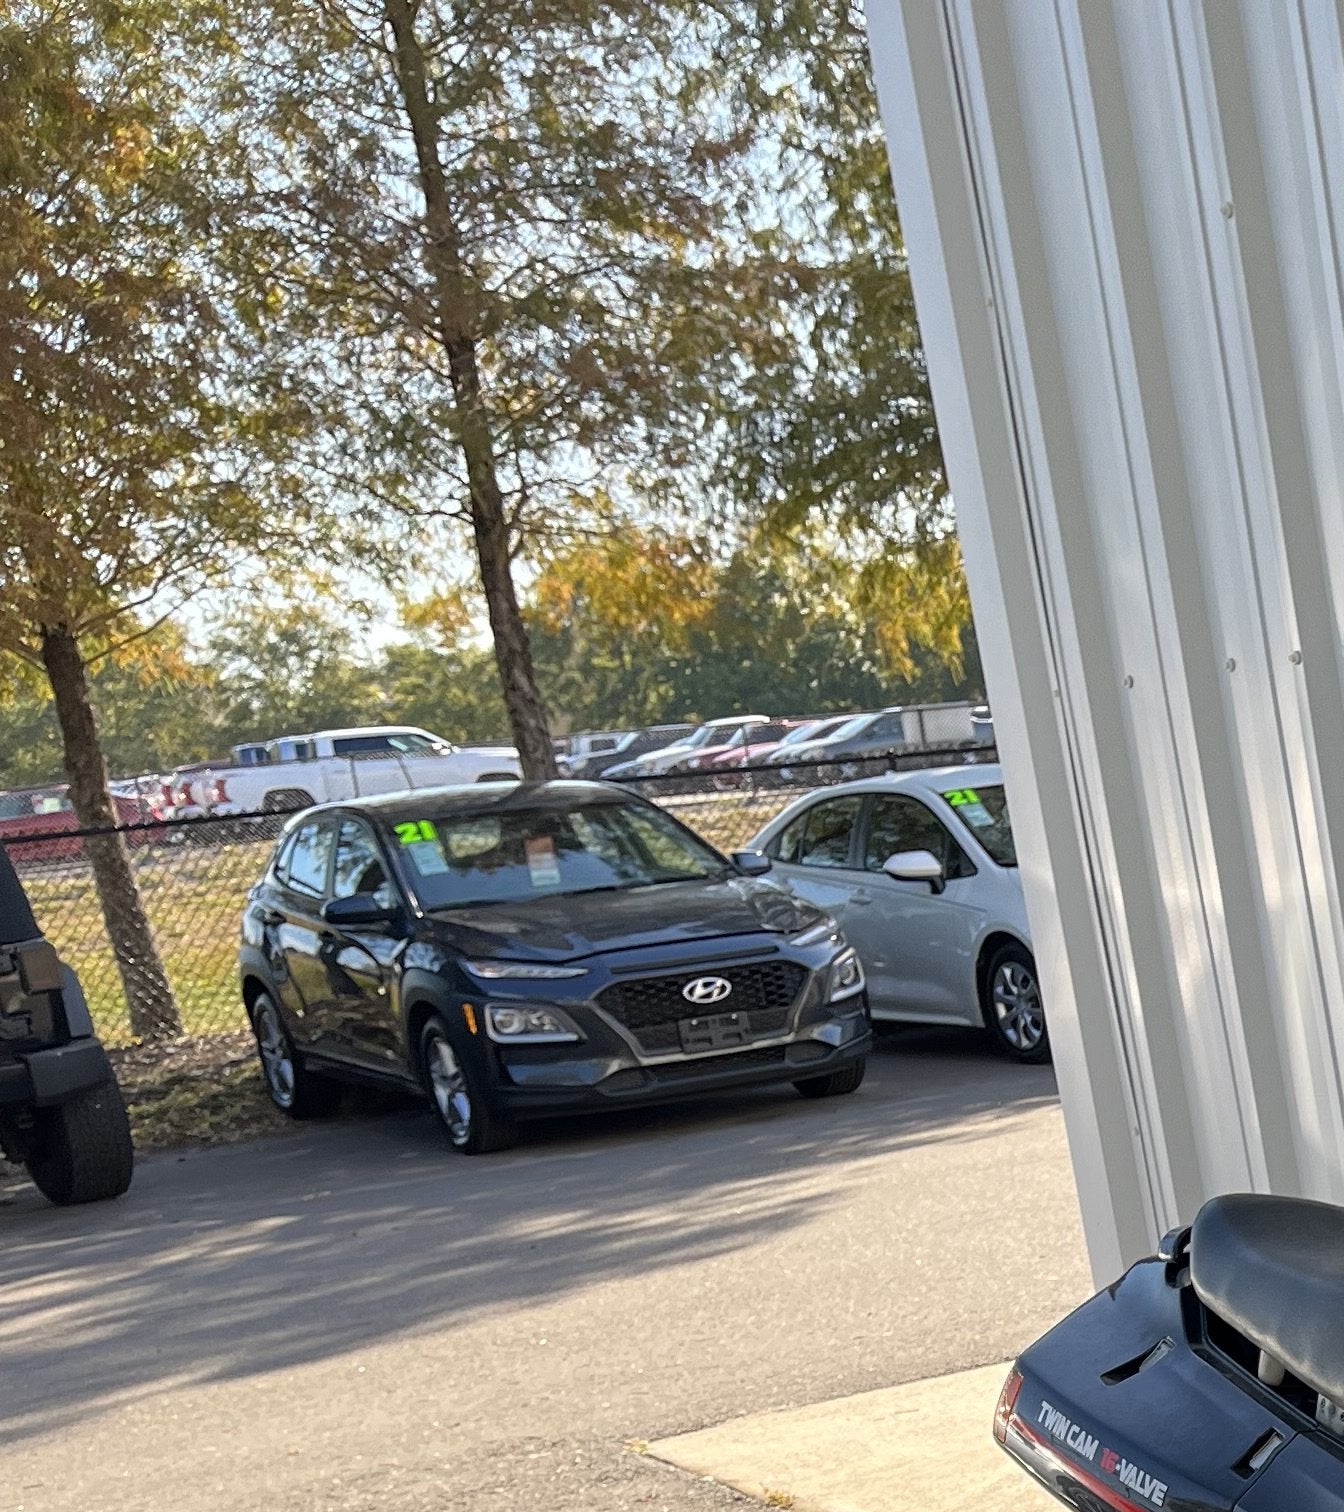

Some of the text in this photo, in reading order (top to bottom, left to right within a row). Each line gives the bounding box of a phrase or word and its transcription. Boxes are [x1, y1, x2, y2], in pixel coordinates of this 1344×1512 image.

[944, 789, 978, 806] 21
[393, 820, 437, 843] 21
[1035, 1400, 1070, 1441] TWIN
[1067, 1425, 1099, 1461] CAM
